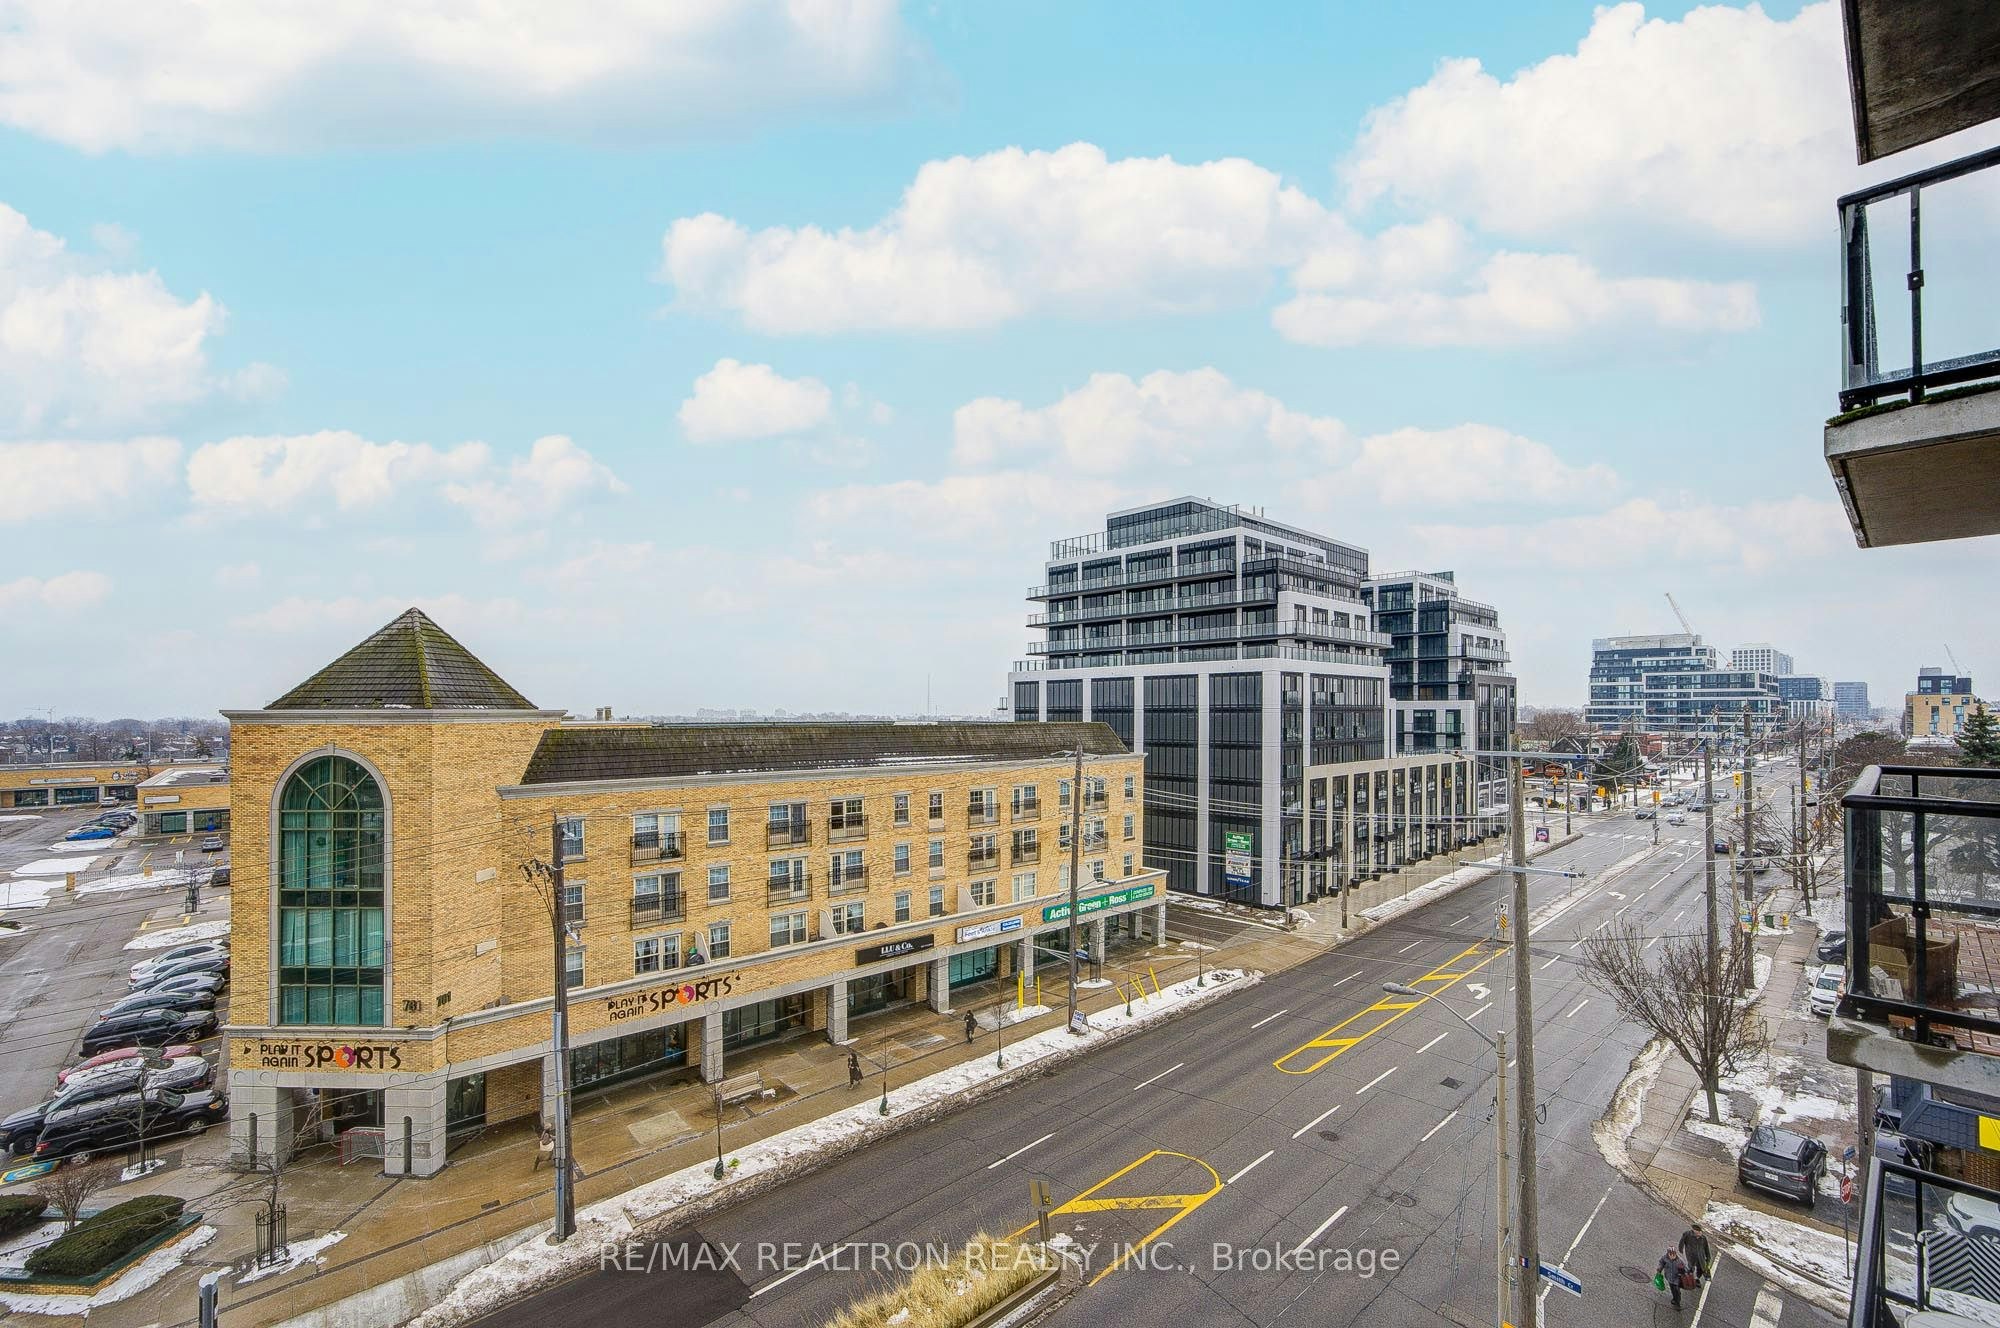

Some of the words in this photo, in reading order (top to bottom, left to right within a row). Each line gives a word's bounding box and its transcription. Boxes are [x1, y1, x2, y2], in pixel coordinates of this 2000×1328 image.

[1049, 907, 1072, 920] Activ
[1078, 900, 1101, 912] Green
[1109, 894, 1127, 905] Ross
[650, 976, 732, 1012] SPORTS
[607, 997, 635, 1011] PLAY
[609, 1006, 644, 1021] AGAIN
[260, 1044, 288, 1055] PLAY
[291, 1045, 301, 1055] IT
[262, 1056, 299, 1067] AGAIN
[304, 1046, 401, 1069] SPORTS
